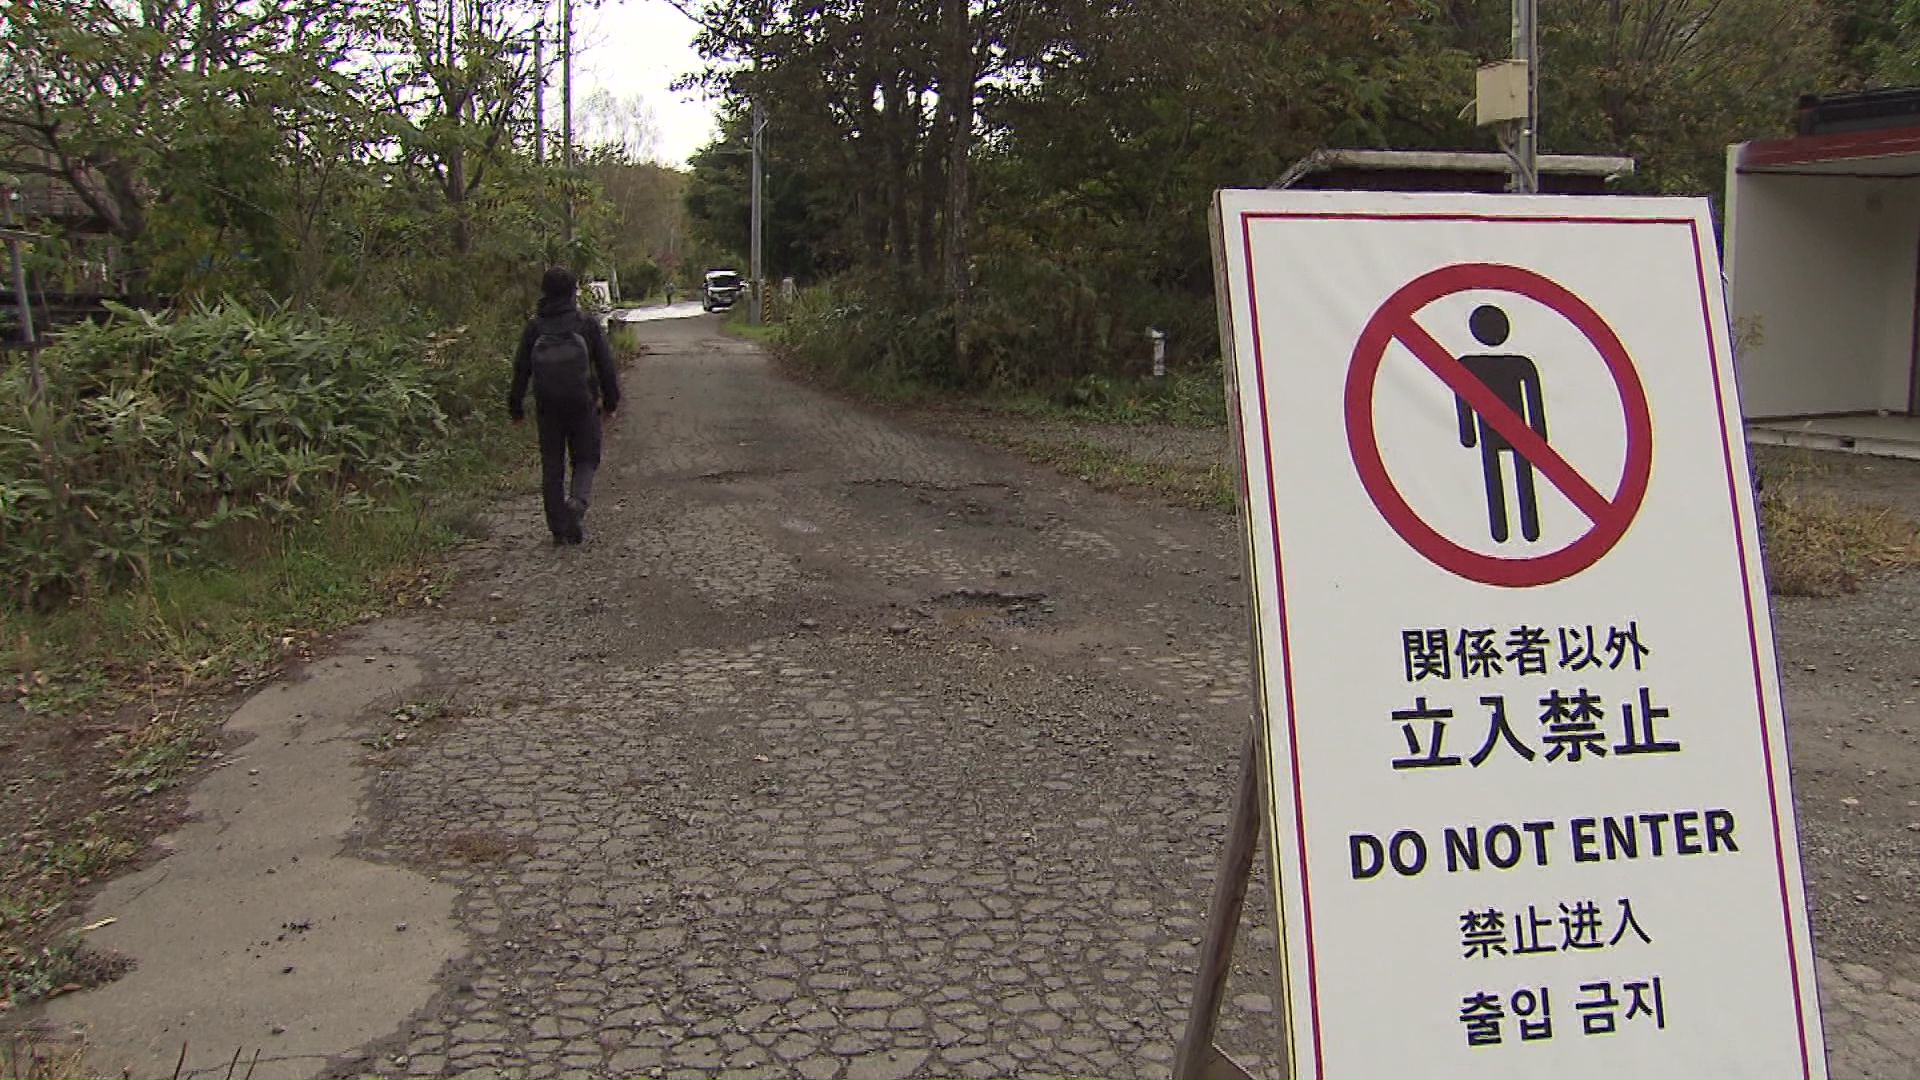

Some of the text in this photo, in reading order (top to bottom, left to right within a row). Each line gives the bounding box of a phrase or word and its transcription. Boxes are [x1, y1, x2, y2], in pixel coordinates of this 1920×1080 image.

[1402, 621, 1650, 682] 関係者以外
[1391, 687, 1681, 770] 立入禁止
[1349, 808, 1739, 880] DO NOT ENTER
[1459, 898, 1652, 959] 禁止进入
[1459, 976, 1665, 1046] 출입 금지
